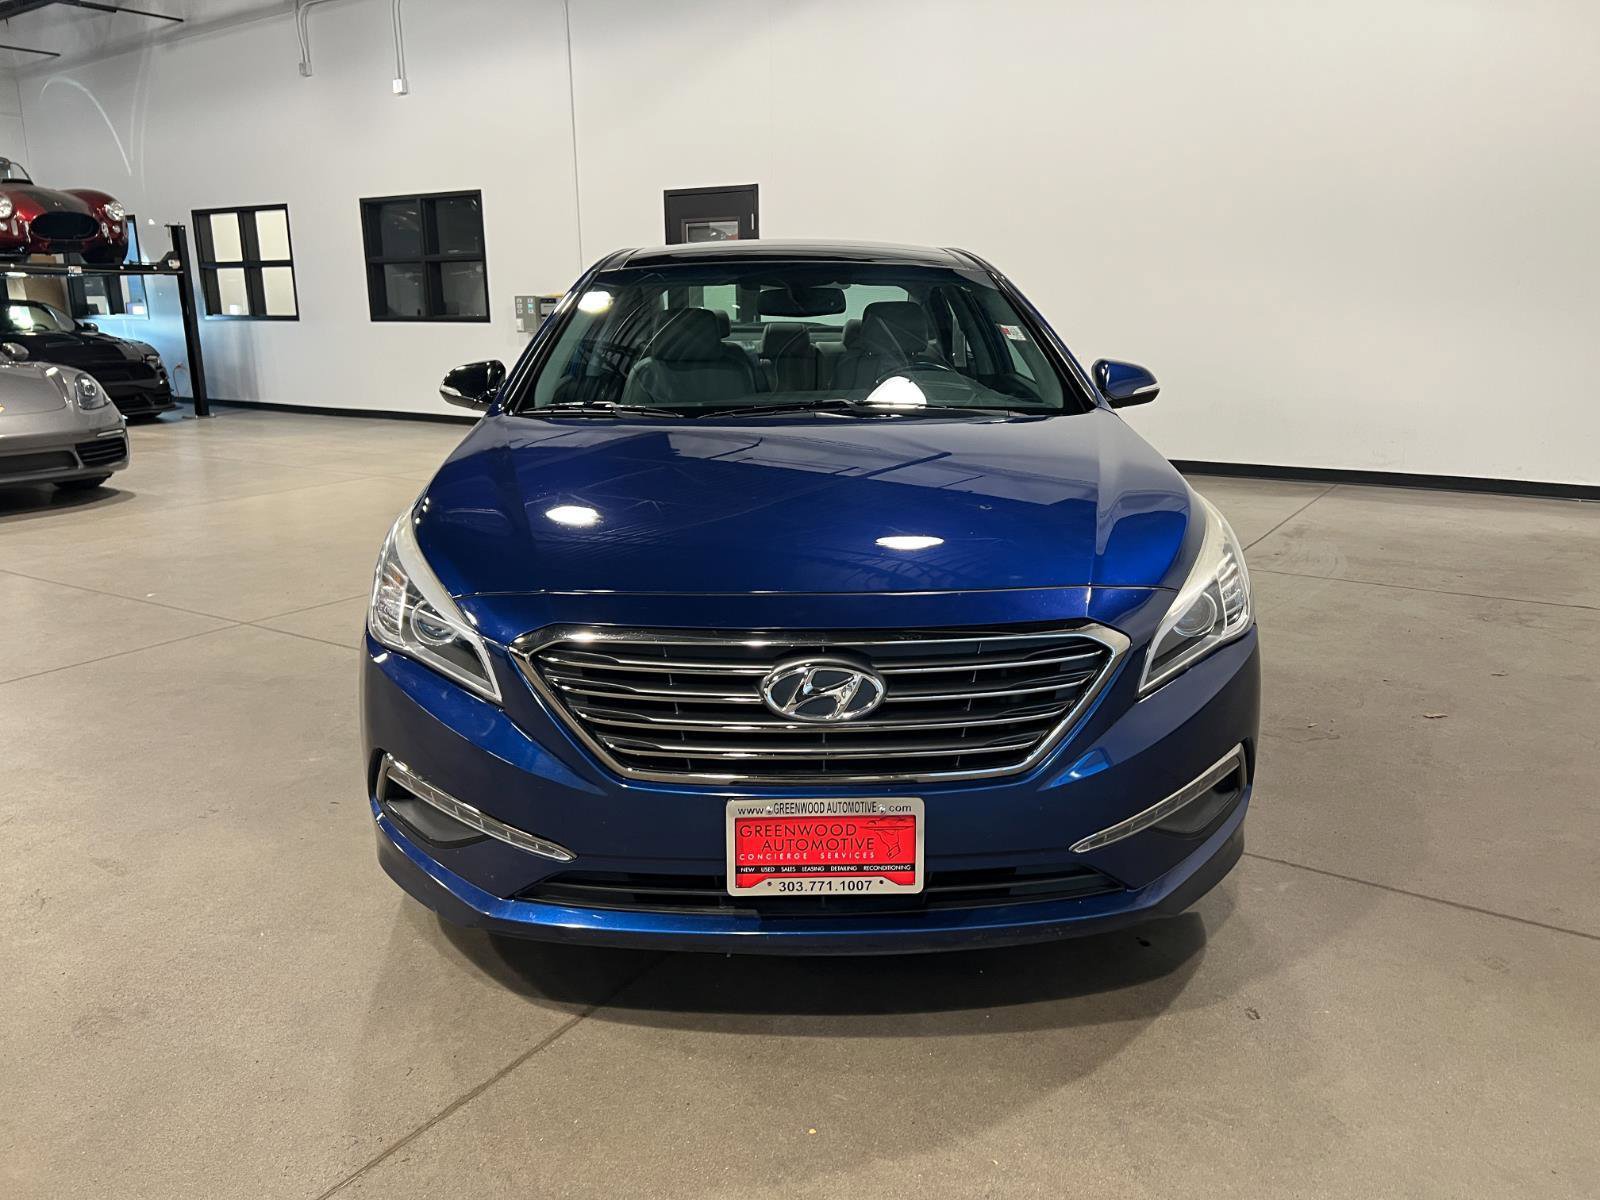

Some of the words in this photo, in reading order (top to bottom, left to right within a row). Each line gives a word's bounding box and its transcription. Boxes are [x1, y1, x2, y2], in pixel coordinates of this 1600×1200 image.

[773, 802, 825, 815] GREENWOOD
[827, 801, 877, 813] AUTOMOTIVE
[740, 824, 857, 837] GREENWOOD
[762, 838, 875, 851] AUTOMOTIVE
[778, 880, 873, 892] 303.771.1007
